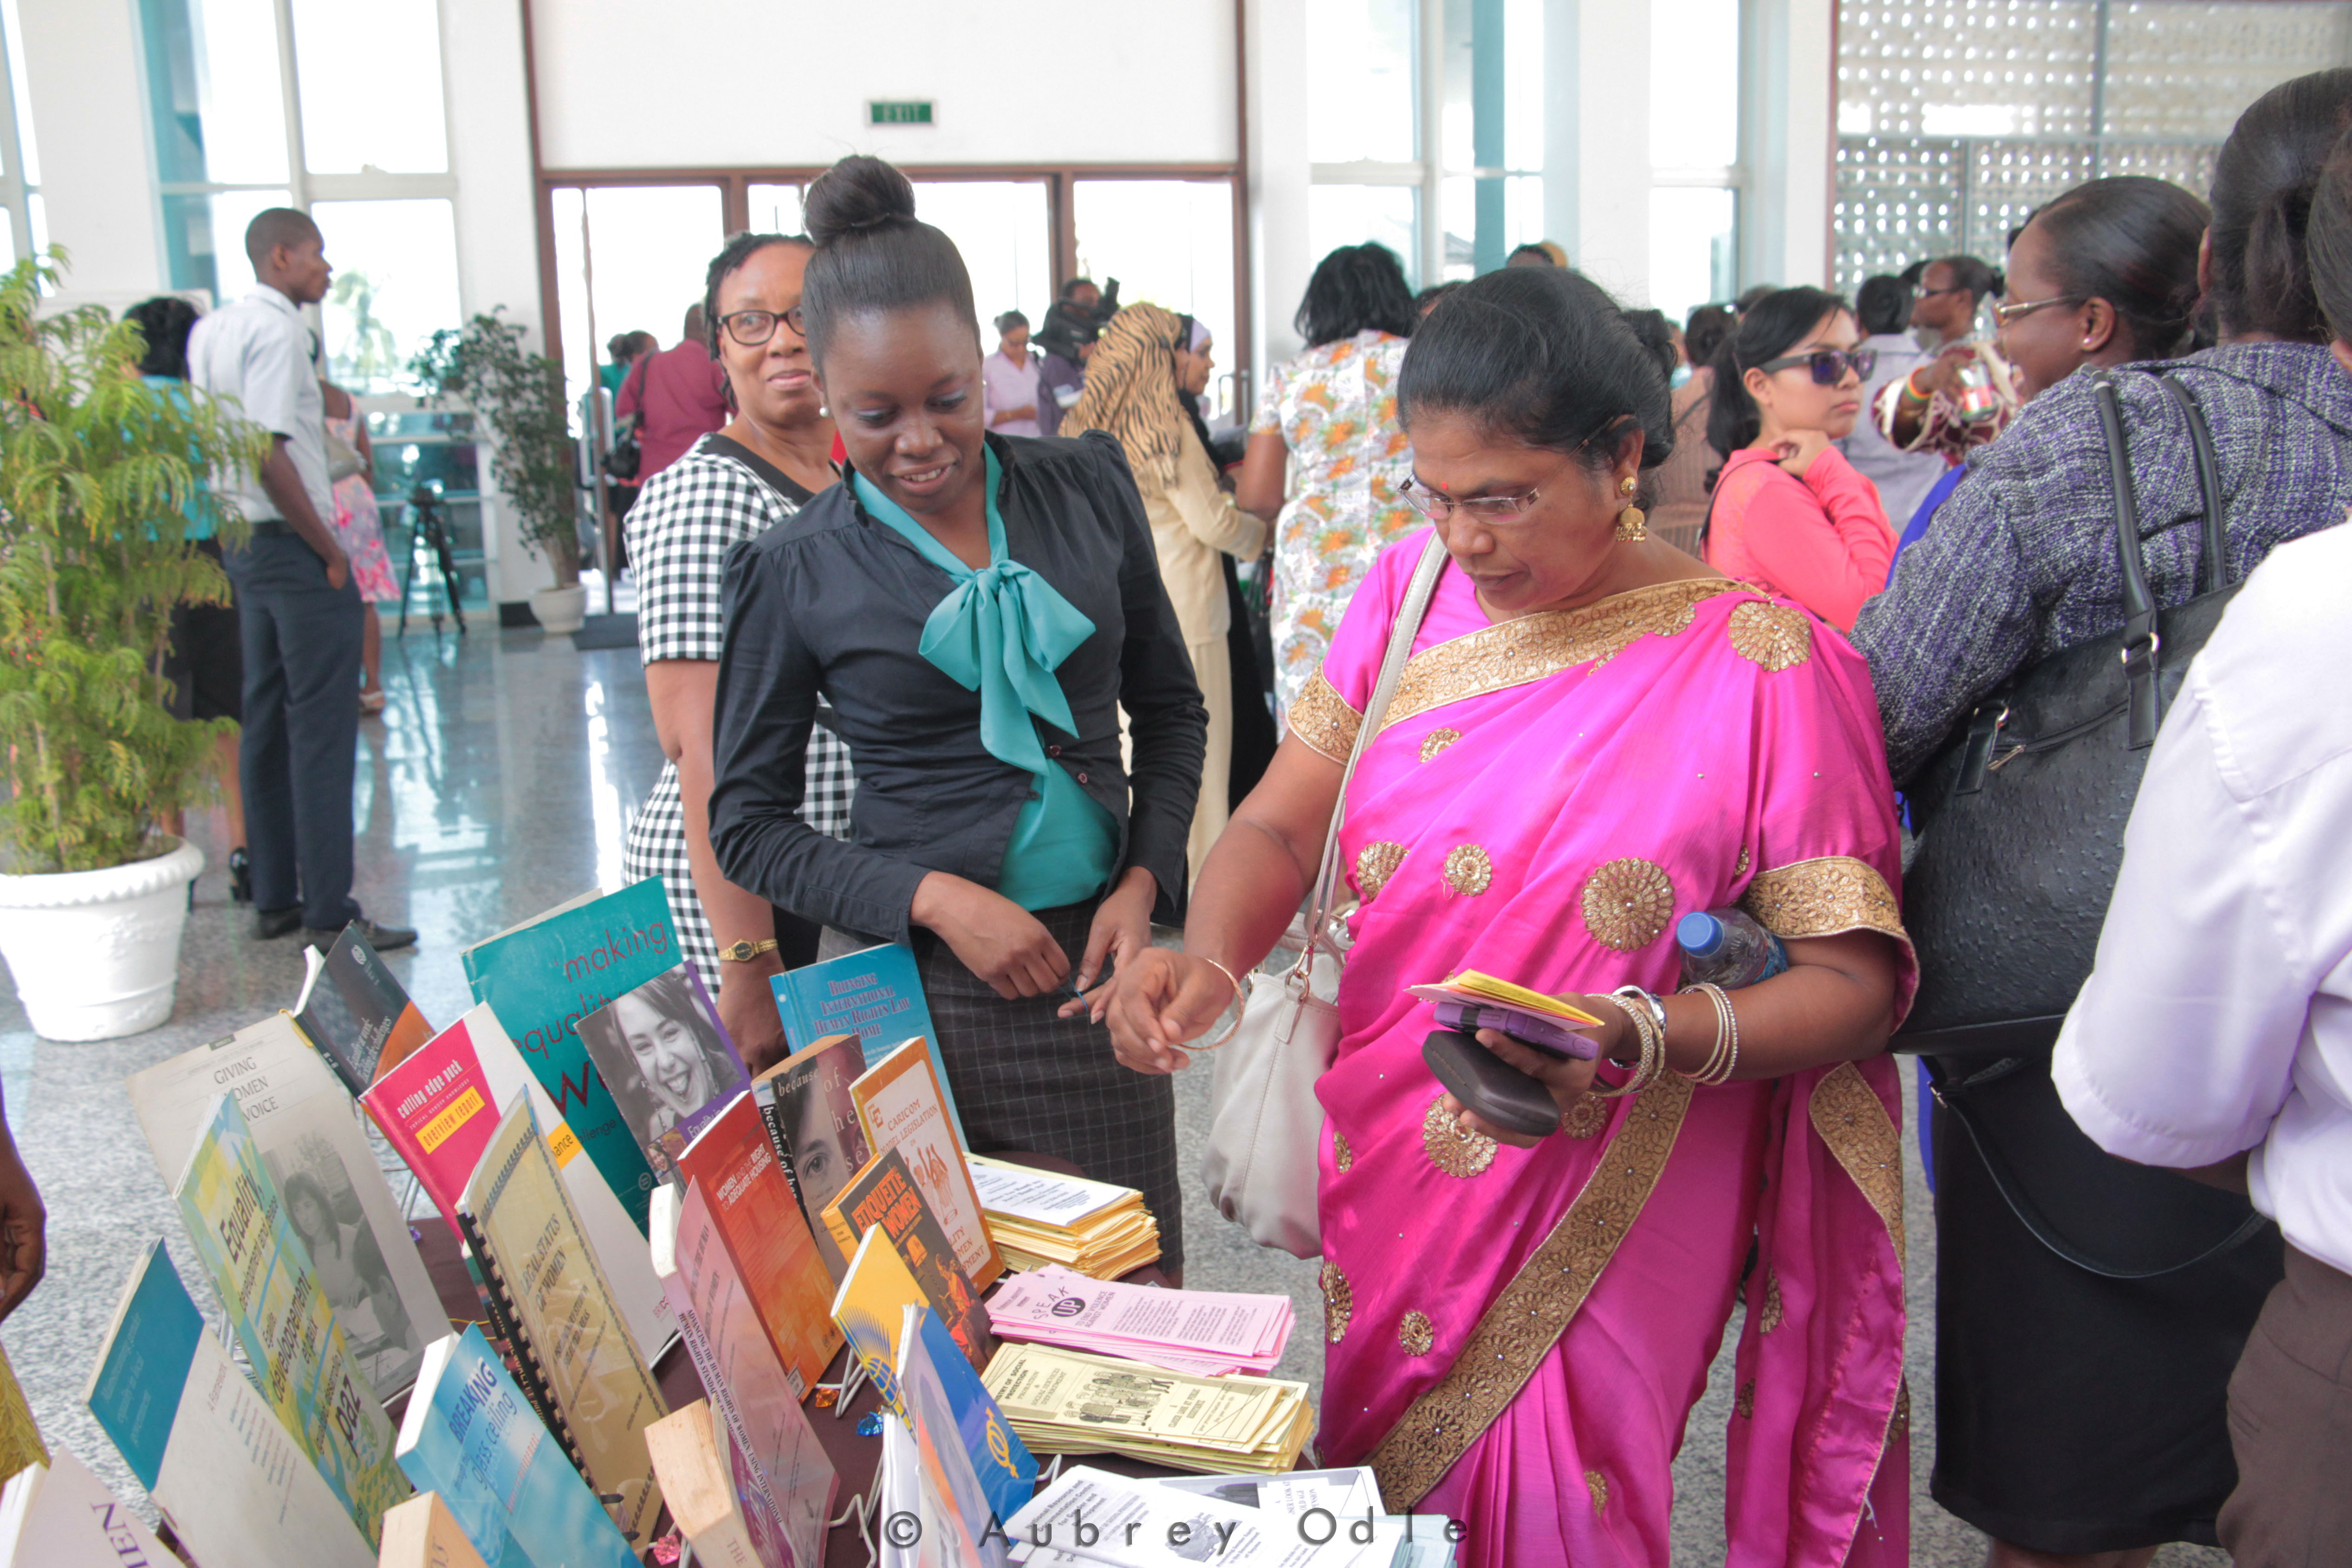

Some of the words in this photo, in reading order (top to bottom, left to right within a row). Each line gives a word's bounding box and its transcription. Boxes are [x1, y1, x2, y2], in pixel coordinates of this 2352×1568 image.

[883, 105, 923, 122] EXIT
[214, 1057, 257, 1084] GIVING
[225, 1076, 269, 1101] OMEN
[422, 1072, 447, 1097] edge
[442, 1057, 464, 1083] pack
[778, 1069, 818, 1096] because
[824, 1067, 841, 1093] of
[242, 1096, 278, 1122] VOICE
[409, 1113, 429, 1130] TOPICAL
[428, 1098, 447, 1114] GENDER
[446, 1078, 470, 1100] KNOWLEDGE
[421, 1113, 457, 1146] overview
[454, 1093, 480, 1119] report
[834, 1109, 855, 1132] he
[886, 1097, 922, 1132] CARICOM
[762, 1106, 785, 1156] because
[780, 1160, 793, 1176] of
[879, 1135, 900, 1156] MODEL
[899, 1103, 940, 1140] LEGISLATION
[716, 1174, 739, 1201] WOMEN
[735, 1165, 747, 1180] AND
[749, 1142, 767, 1165] RIGHT
[721, 1199, 731, 1212] TO
[726, 1173, 753, 1205] ADEQUATE
[749, 1151, 772, 1180] HOUSING
[218, 1168, 265, 1264] Equality,
[851, 1165, 907, 1235] ETIQUETTE
[881, 1185, 923, 1239] WOMEN
[947, 1225, 965, 1247] LITY
[519, 1253, 542, 1297] LEGAL
[534, 1212, 563, 1260] STATUS
[238, 1237, 265, 1312] development
[534, 1288, 548, 1312] OF
[541, 1244, 566, 1294] WOMEN
[1032, 1287, 1069, 1321] SPEAK
[1053, 1298, 1081, 1317] UP
[1080, 1312, 1092, 1321] END
[1088, 1291, 1108, 1311] VIOLENCE
[1084, 1310, 1102, 1327] AGAINST
[1099, 1291, 1115, 1310] WOMEN
[302, 1314, 319, 1354] paix
[677, 1313, 694, 1339] HUMAN
[688, 1339, 705, 1365] RIGHTS
[687, 1308, 708, 1346] ADVANCING
[299, 1343, 312, 1364] et
[702, 1347, 714, 1362] THE
[708, 1362, 725, 1387] HUMAN
[994, 1384, 1007, 1403] NISTRY
[1005, 1377, 1012, 1385] OF
[1011, 1358, 1026, 1376] SOCIAL
[1005, 1369, 1029, 1399] PROTECTION
[1017, 1371, 1040, 1399] PROBATION
[1031, 1389, 1046, 1405] SOCIAL
[1042, 1368, 1060, 1388] SERVICES
[1041, 1371, 1066, 1404] DEPARTMENT
[336, 1374, 361, 1458] paz
[448, 1360, 499, 1444] BREAKING
[719, 1387, 736, 1414] RIGHTS
[731, 1413, 741, 1425] OF
[1168, 1414, 1182, 1427] CLOSER
[466, 1442, 494, 1490] glass
[485, 1389, 518, 1445] ceiling
[517, 1432, 540, 1480] management
[734, 1424, 754, 1453] WOMEN:
[461, 1451, 471, 1467] the
[747, 1452, 762, 1474] USING
[1025, 1506, 1050, 1529] National
[1047, 1486, 1072, 1510] Resource
[1072, 1478, 1083, 1489] and
[1038, 1496, 1077, 1532] Documentation
[1075, 1481, 1094, 1498] Centre
[1058, 1516, 1069, 1527] for
[1083, 1491, 1097, 1505] and
[726, 1537, 748, 1568] THE
[1216, 1548, 1235, 1567] Promoting
[1233, 1536, 1246, 1549] Gender
[1244, 1525, 1256, 1537] Equity
[1239, 1531, 1260, 1553] Development
[1247, 1541, 1261, 1554] Guyana
